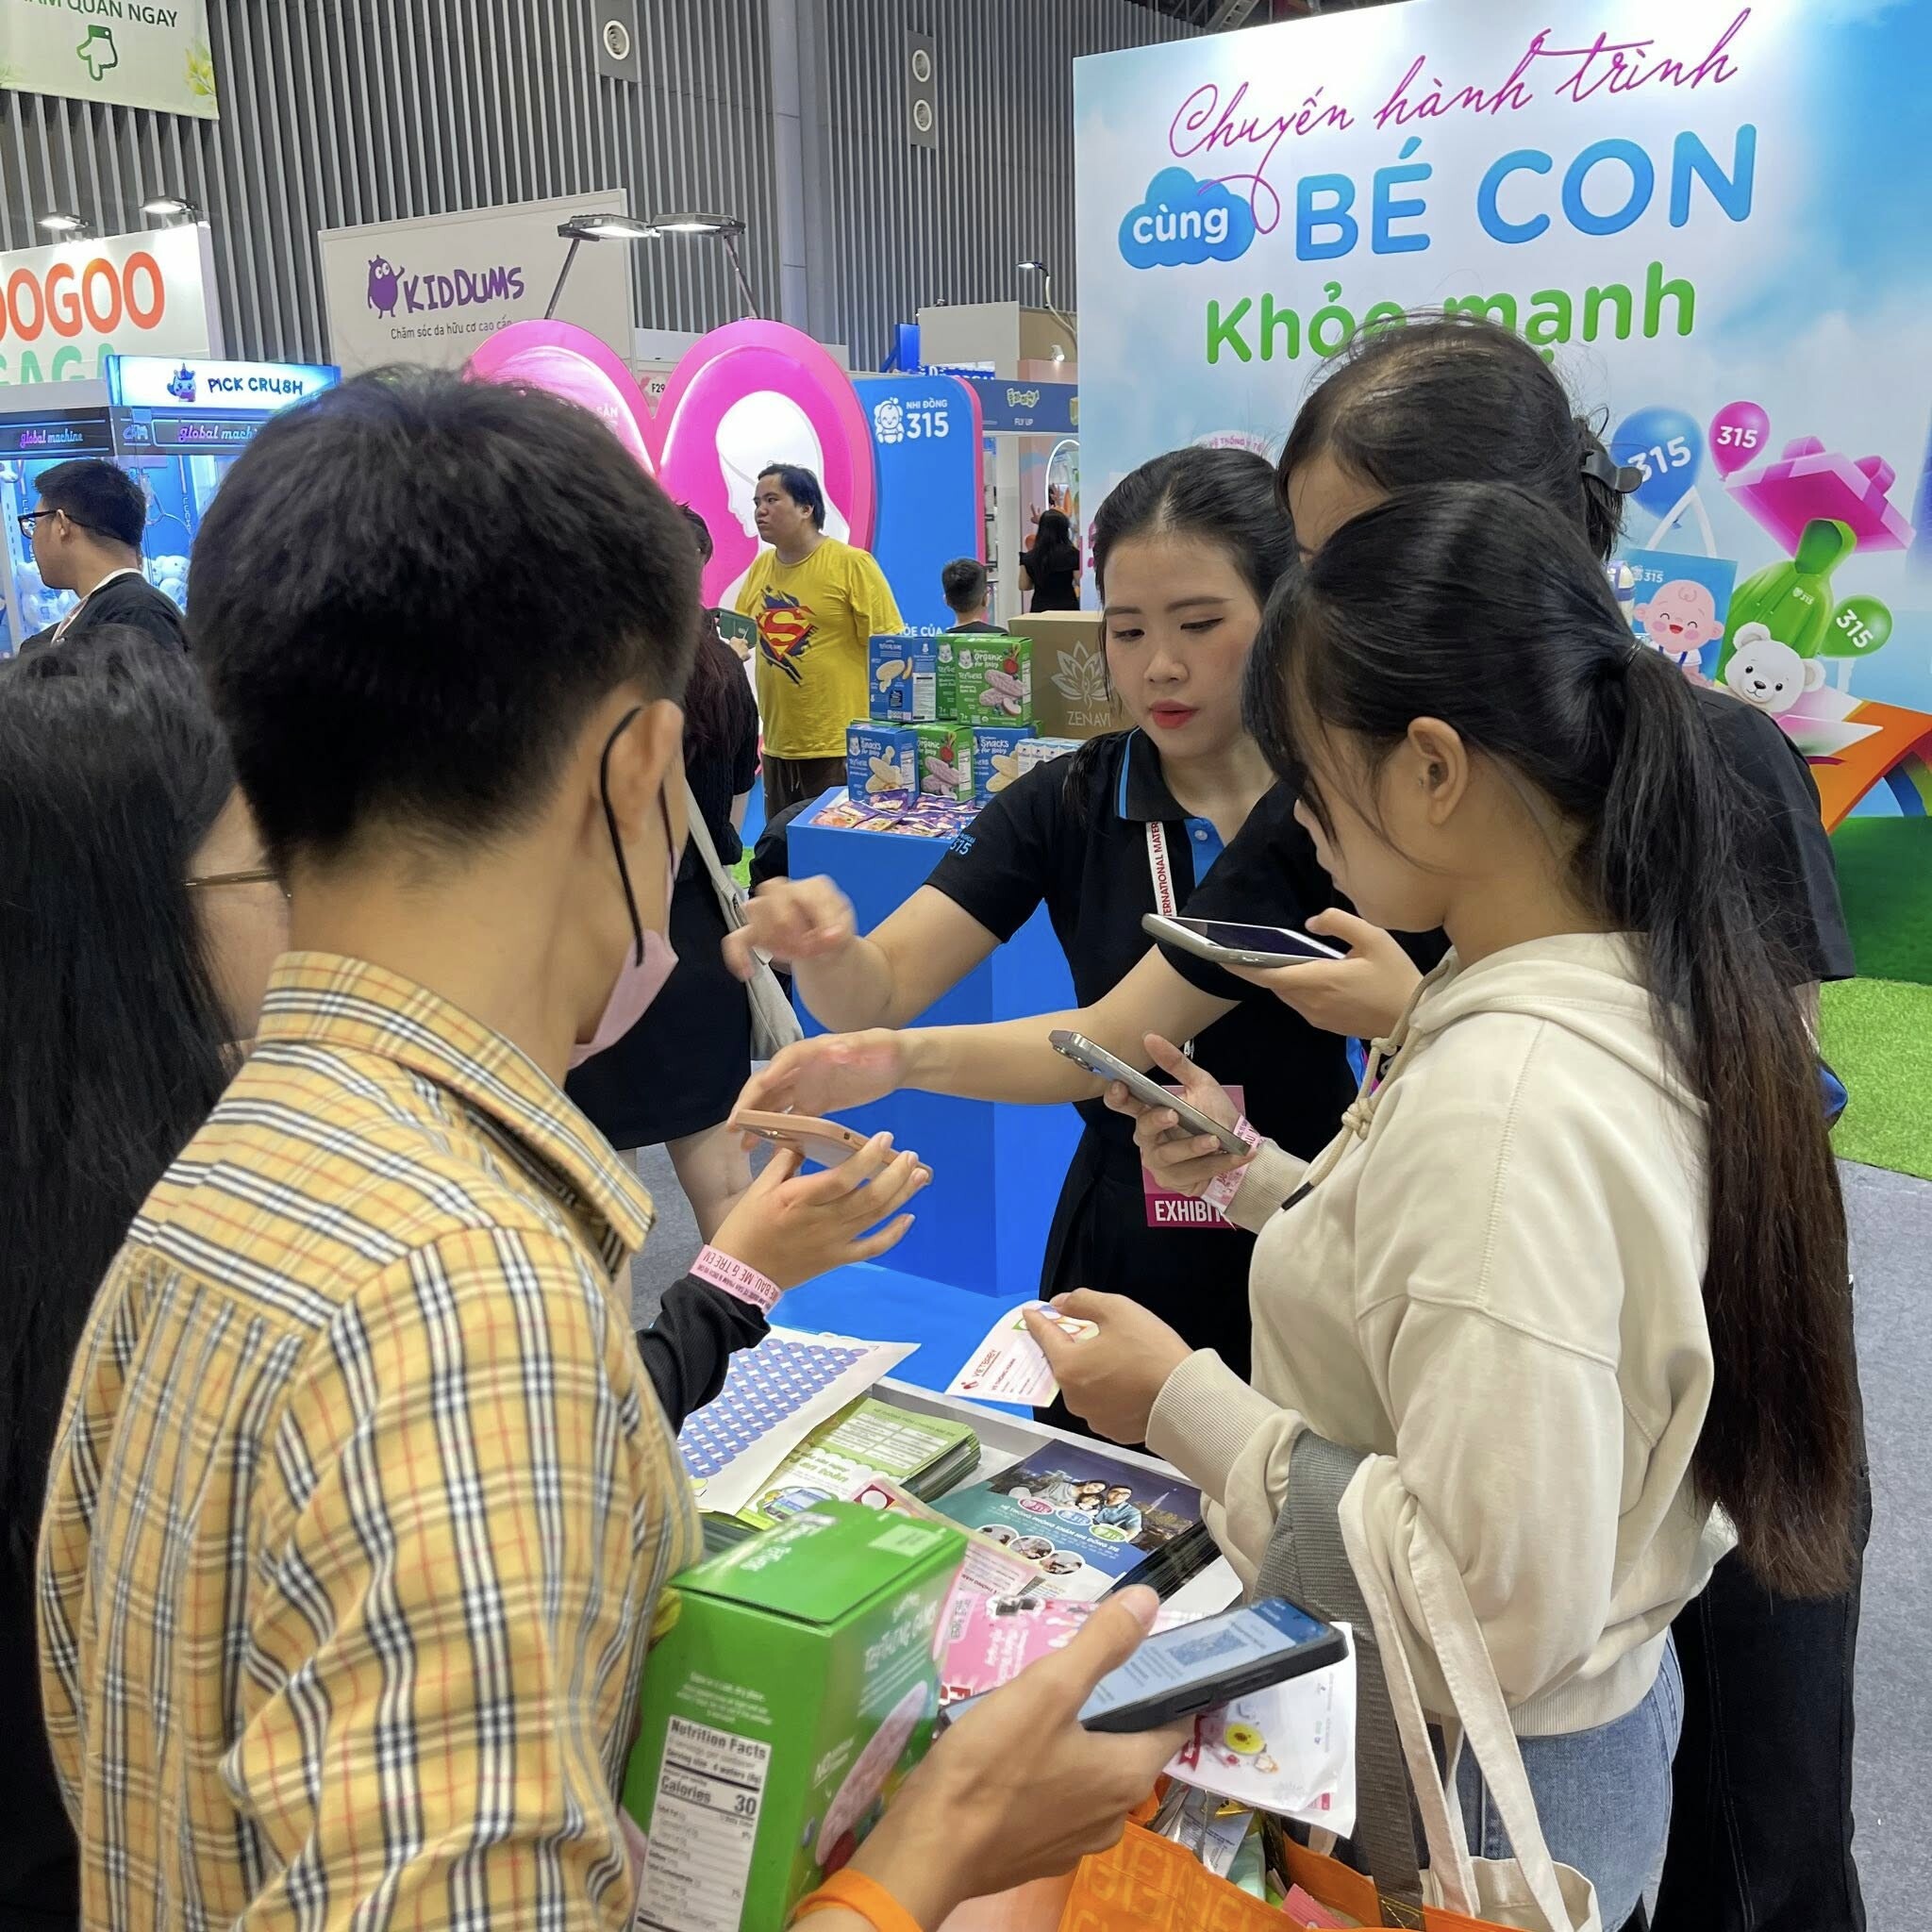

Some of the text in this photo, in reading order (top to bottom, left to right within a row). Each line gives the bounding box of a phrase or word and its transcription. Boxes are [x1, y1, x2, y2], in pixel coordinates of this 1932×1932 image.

[128, 5, 177, 27] NGAY
[1170, 8, 1752, 235] Chuyến hành trình
[1295, 124, 1757, 261] BÉ CON
[1132, 202, 1229, 245] cùng
[0, 251, 165, 341] OGOO
[403, 266, 525, 313] KIDDUMS
[391, 327, 415, 340] Chăm
[417, 324, 432, 337] sóc
[434, 324, 444, 335] da
[446, 322, 464, 334] hữu
[478, 322, 494, 331] cao
[651, 383, 666, 393] F29
[906, 397, 948, 409] NHI ĐỒNG
[177, 425, 258, 443] global mach
[906, 411, 950, 439] 315
[1716, 425, 1758, 449] 315
[20, 427, 84, 449] global machine
[1627, 436, 1691, 483] 315
[1644, 572, 1664, 583] 315
[1800, 592, 1815, 606] 315
[1835, 608, 1874, 649] 315
[1066, 710, 1112, 727] ZENAVI
[980, 739, 1009, 748] Snacks
[1151, 821, 1173, 917] TERNATIONAL MATER
[1155, 1200, 1221, 1223] EXHIBI
[671, 1719, 726, 1749] Nutrition
[729, 1737, 766, 1760] Facts
[660, 1775, 711, 1805] Calories
[734, 1793, 757, 1816] 30
